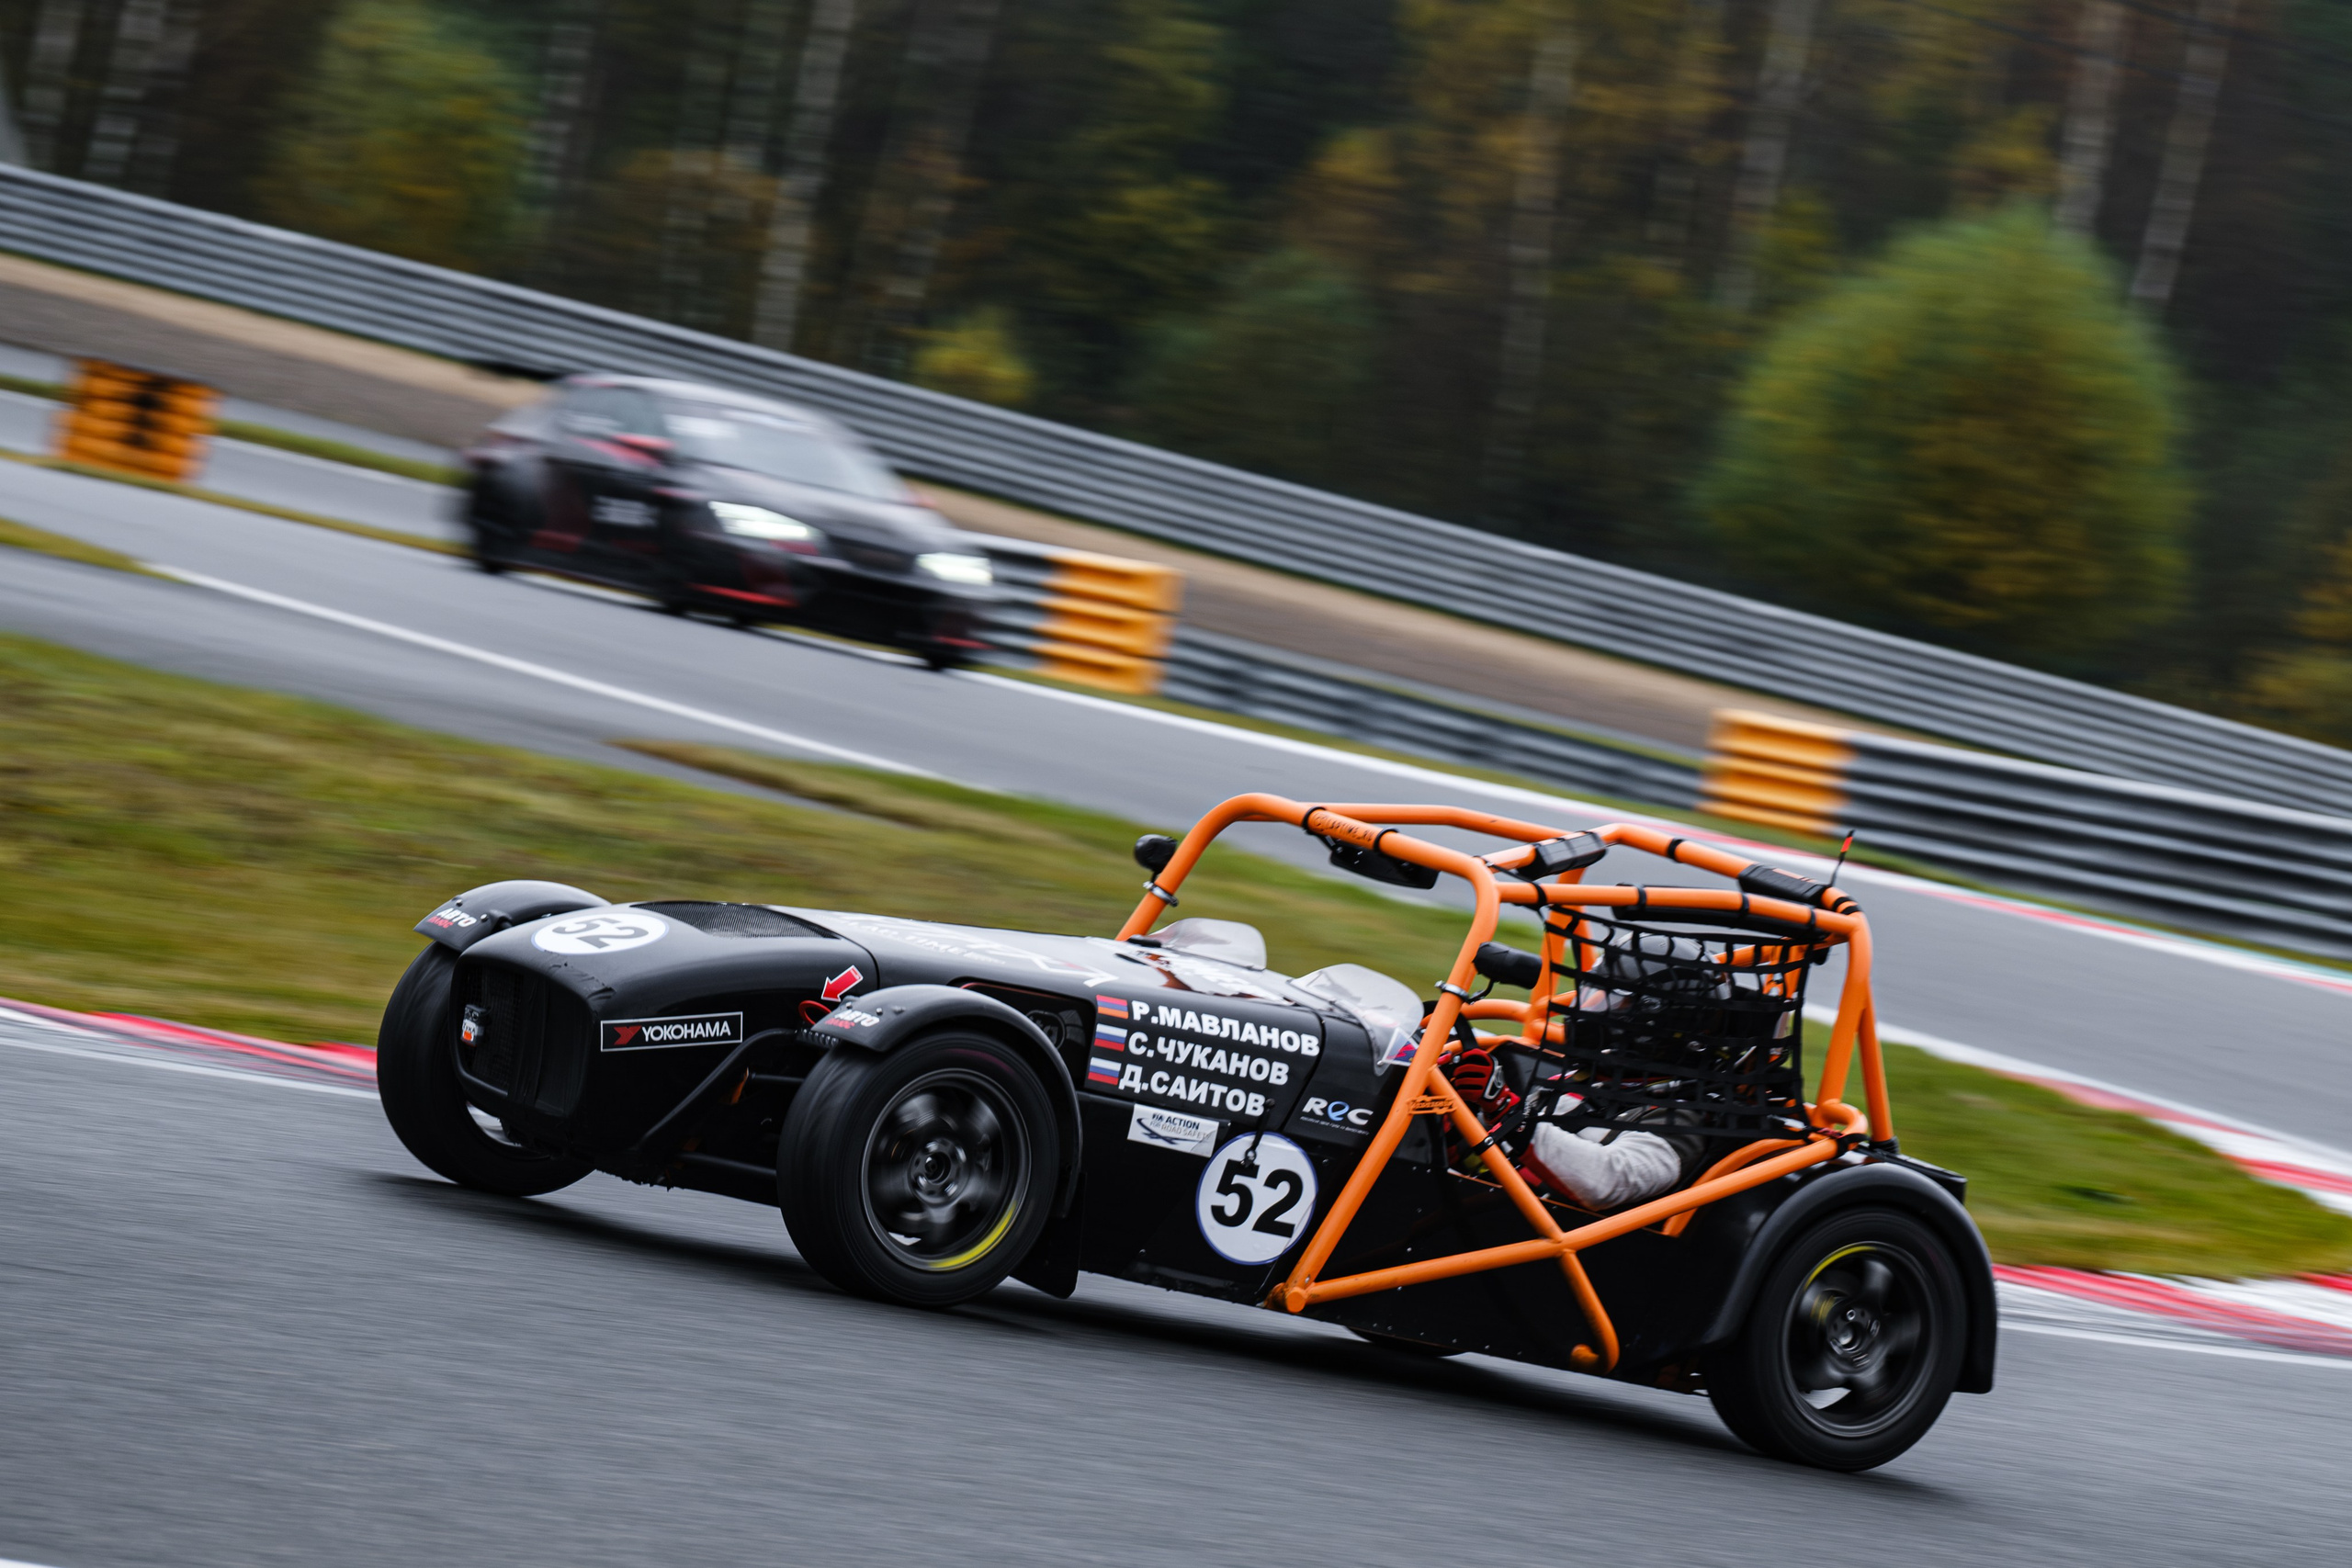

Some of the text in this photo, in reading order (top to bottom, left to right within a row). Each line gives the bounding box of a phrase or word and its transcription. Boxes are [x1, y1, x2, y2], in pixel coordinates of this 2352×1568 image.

[436, 908, 477, 928] АВТО
[552, 917, 649, 949] 52
[642, 1021, 731, 1042] YOKOHAMA
[834, 1010, 880, 1027] АВТО
[1131, 1000, 1320, 1056] Р.МАВЛАНОВ
[1128, 1032, 1289, 1086] С.ЧУКАНОВ
[1118, 1064, 1266, 1117] Д.САИТОВ
[1161, 1123, 1182, 1134] ROAD
[1165, 1116, 1200, 1130] ACTION
[1211, 1159, 1304, 1238] 52
